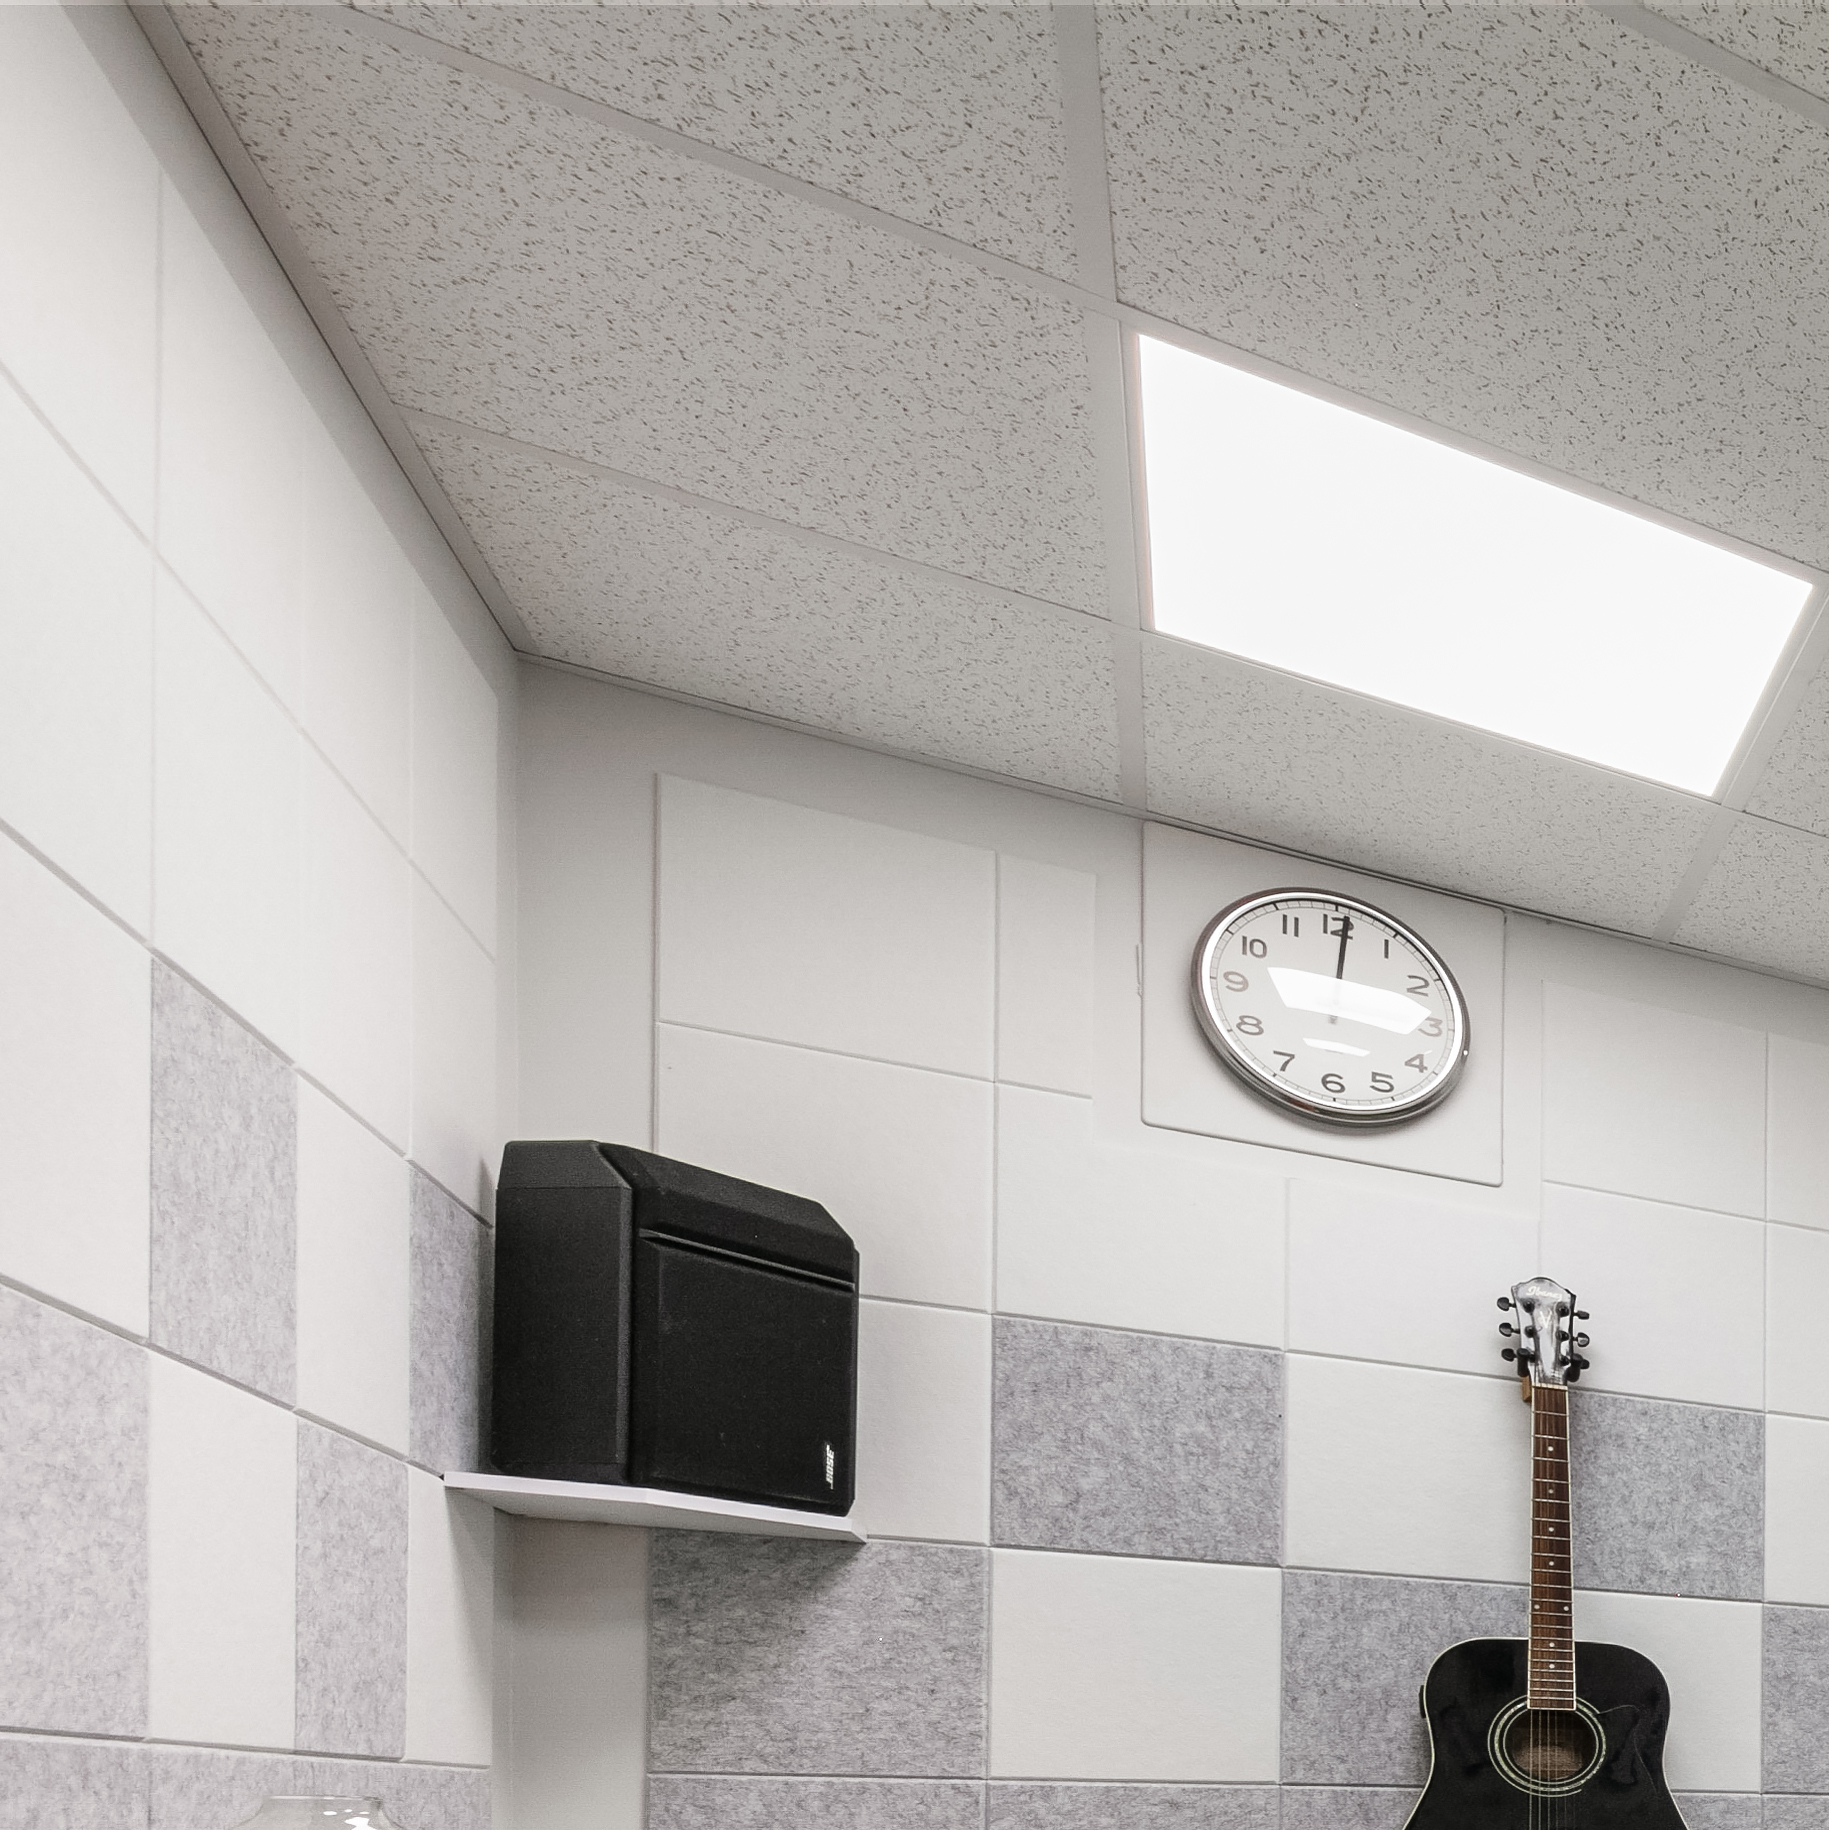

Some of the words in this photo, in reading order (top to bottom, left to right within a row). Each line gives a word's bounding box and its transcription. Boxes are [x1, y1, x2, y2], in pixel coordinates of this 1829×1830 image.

[1282, 914, 1300, 938] 11
[1322, 914, 1355, 940] 12
[1241, 936, 1268, 959] 10
[1384, 939, 1389, 959] 1
[1223, 971, 1249, 993] 9
[1406, 975, 1430, 997] 2
[1236, 1014, 1264, 1036] 8
[1418, 1016, 1443, 1038] 3
[1272, 1050, 1295, 1072] 7
[1404, 1053, 1429, 1073] 4
[1321, 1072, 1346, 1094] 6
[1369, 1071, 1394, 1093] 5
[1526, 1286, 1563, 1301] Ibanez
[825, 1445, 835, 1490] BOSE
